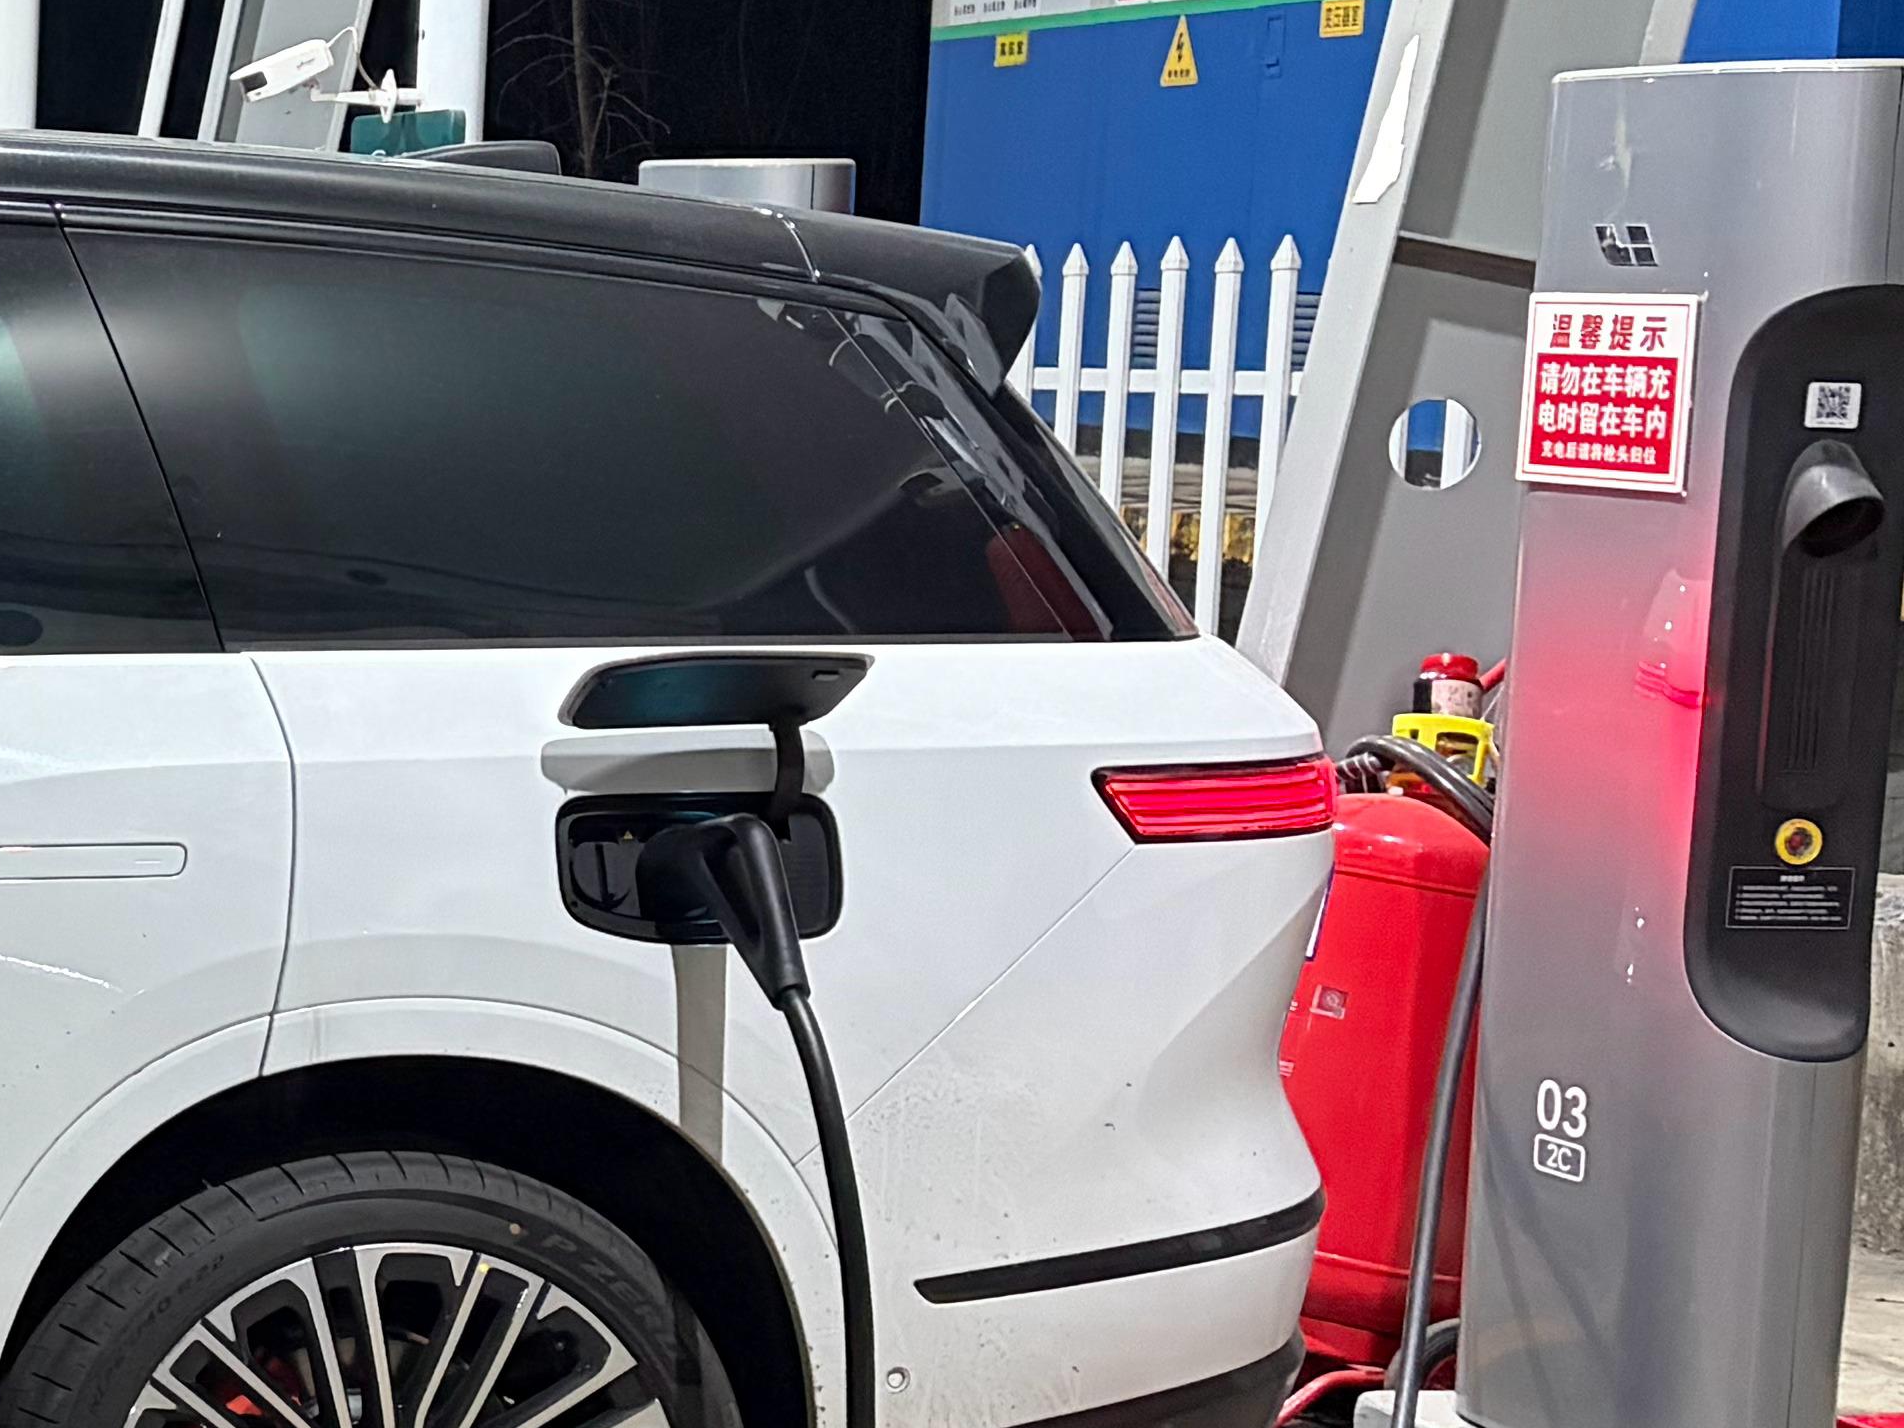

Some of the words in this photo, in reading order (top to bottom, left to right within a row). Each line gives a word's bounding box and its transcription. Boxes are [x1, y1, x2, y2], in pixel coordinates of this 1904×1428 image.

[1549, 313, 1668, 351] 温馨提示
[1540, 361, 1672, 400] 请勿在车辆充
[1537, 400, 1668, 440] 电时留在车内
[1536, 1079, 1587, 1138] 03
[1546, 1143, 1572, 1172] 2C
